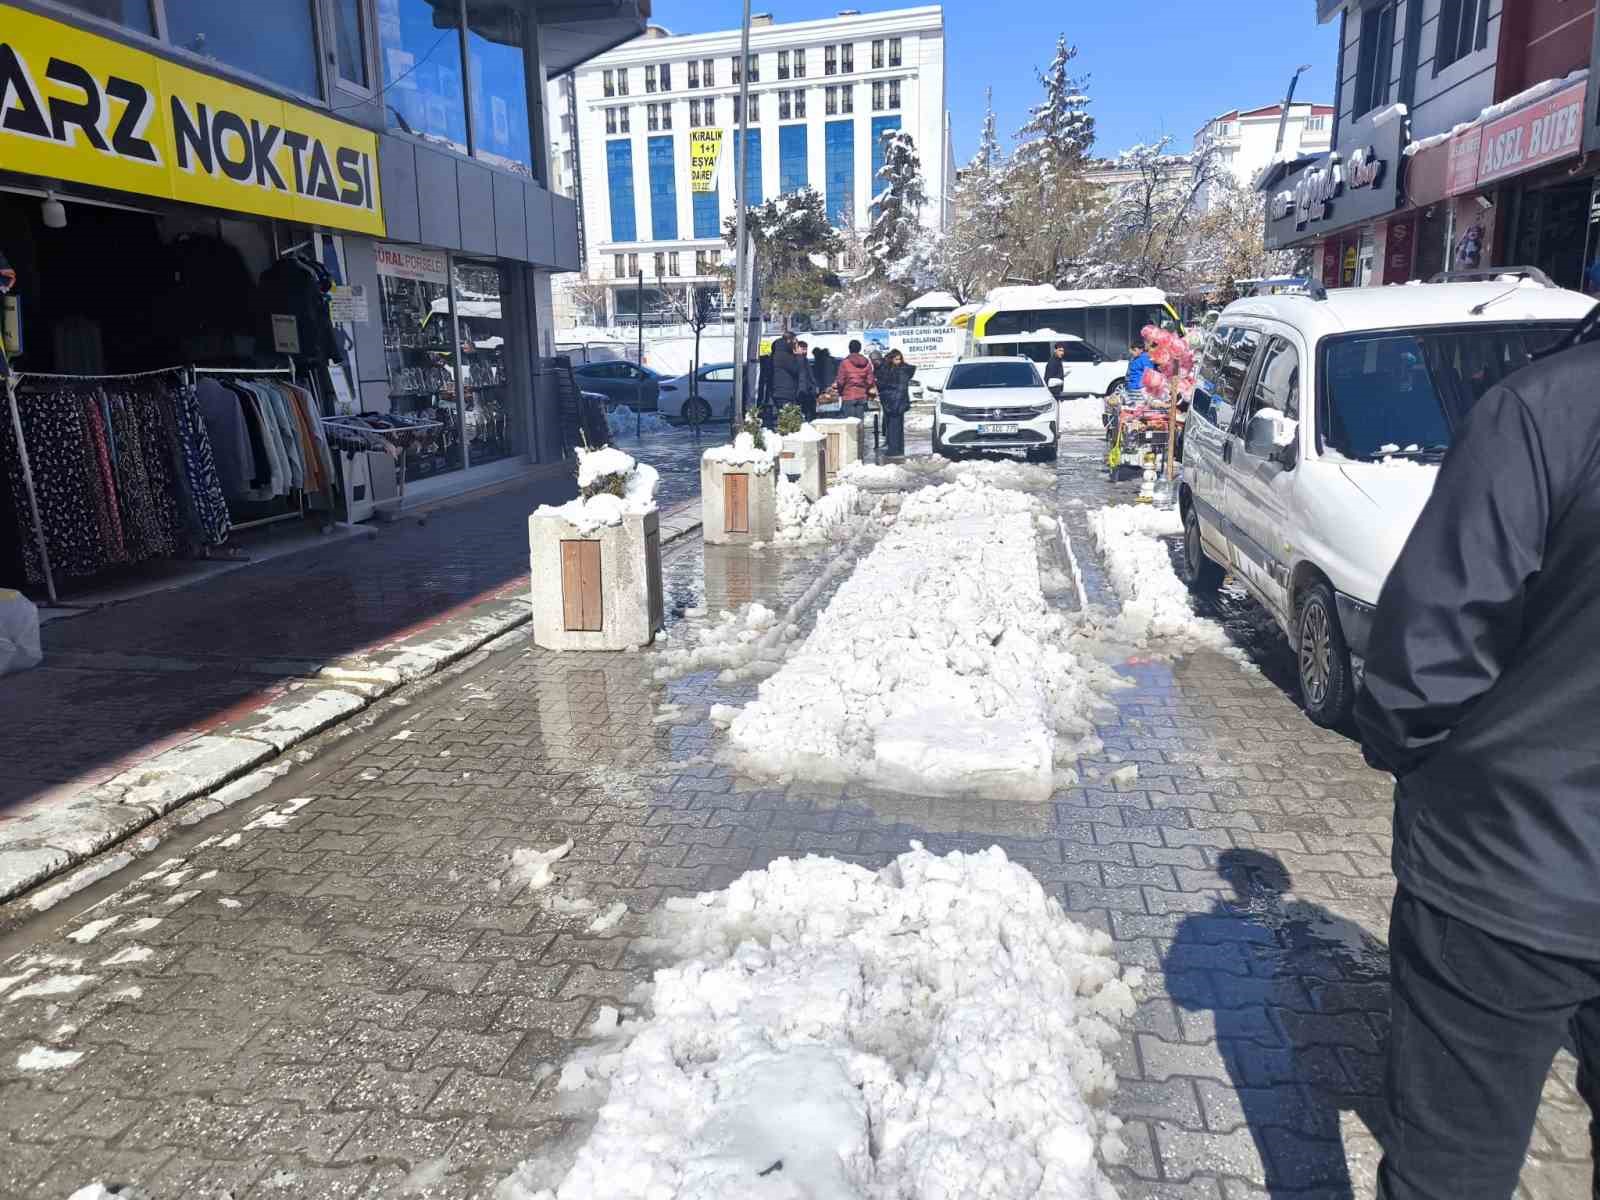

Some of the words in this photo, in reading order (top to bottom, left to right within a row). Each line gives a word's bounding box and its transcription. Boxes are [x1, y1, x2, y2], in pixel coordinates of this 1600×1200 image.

[170, 95, 374, 210] NOKTASI
[700, 144, 715, 154] 1+1
[1481, 126, 1523, 175] ASEL
